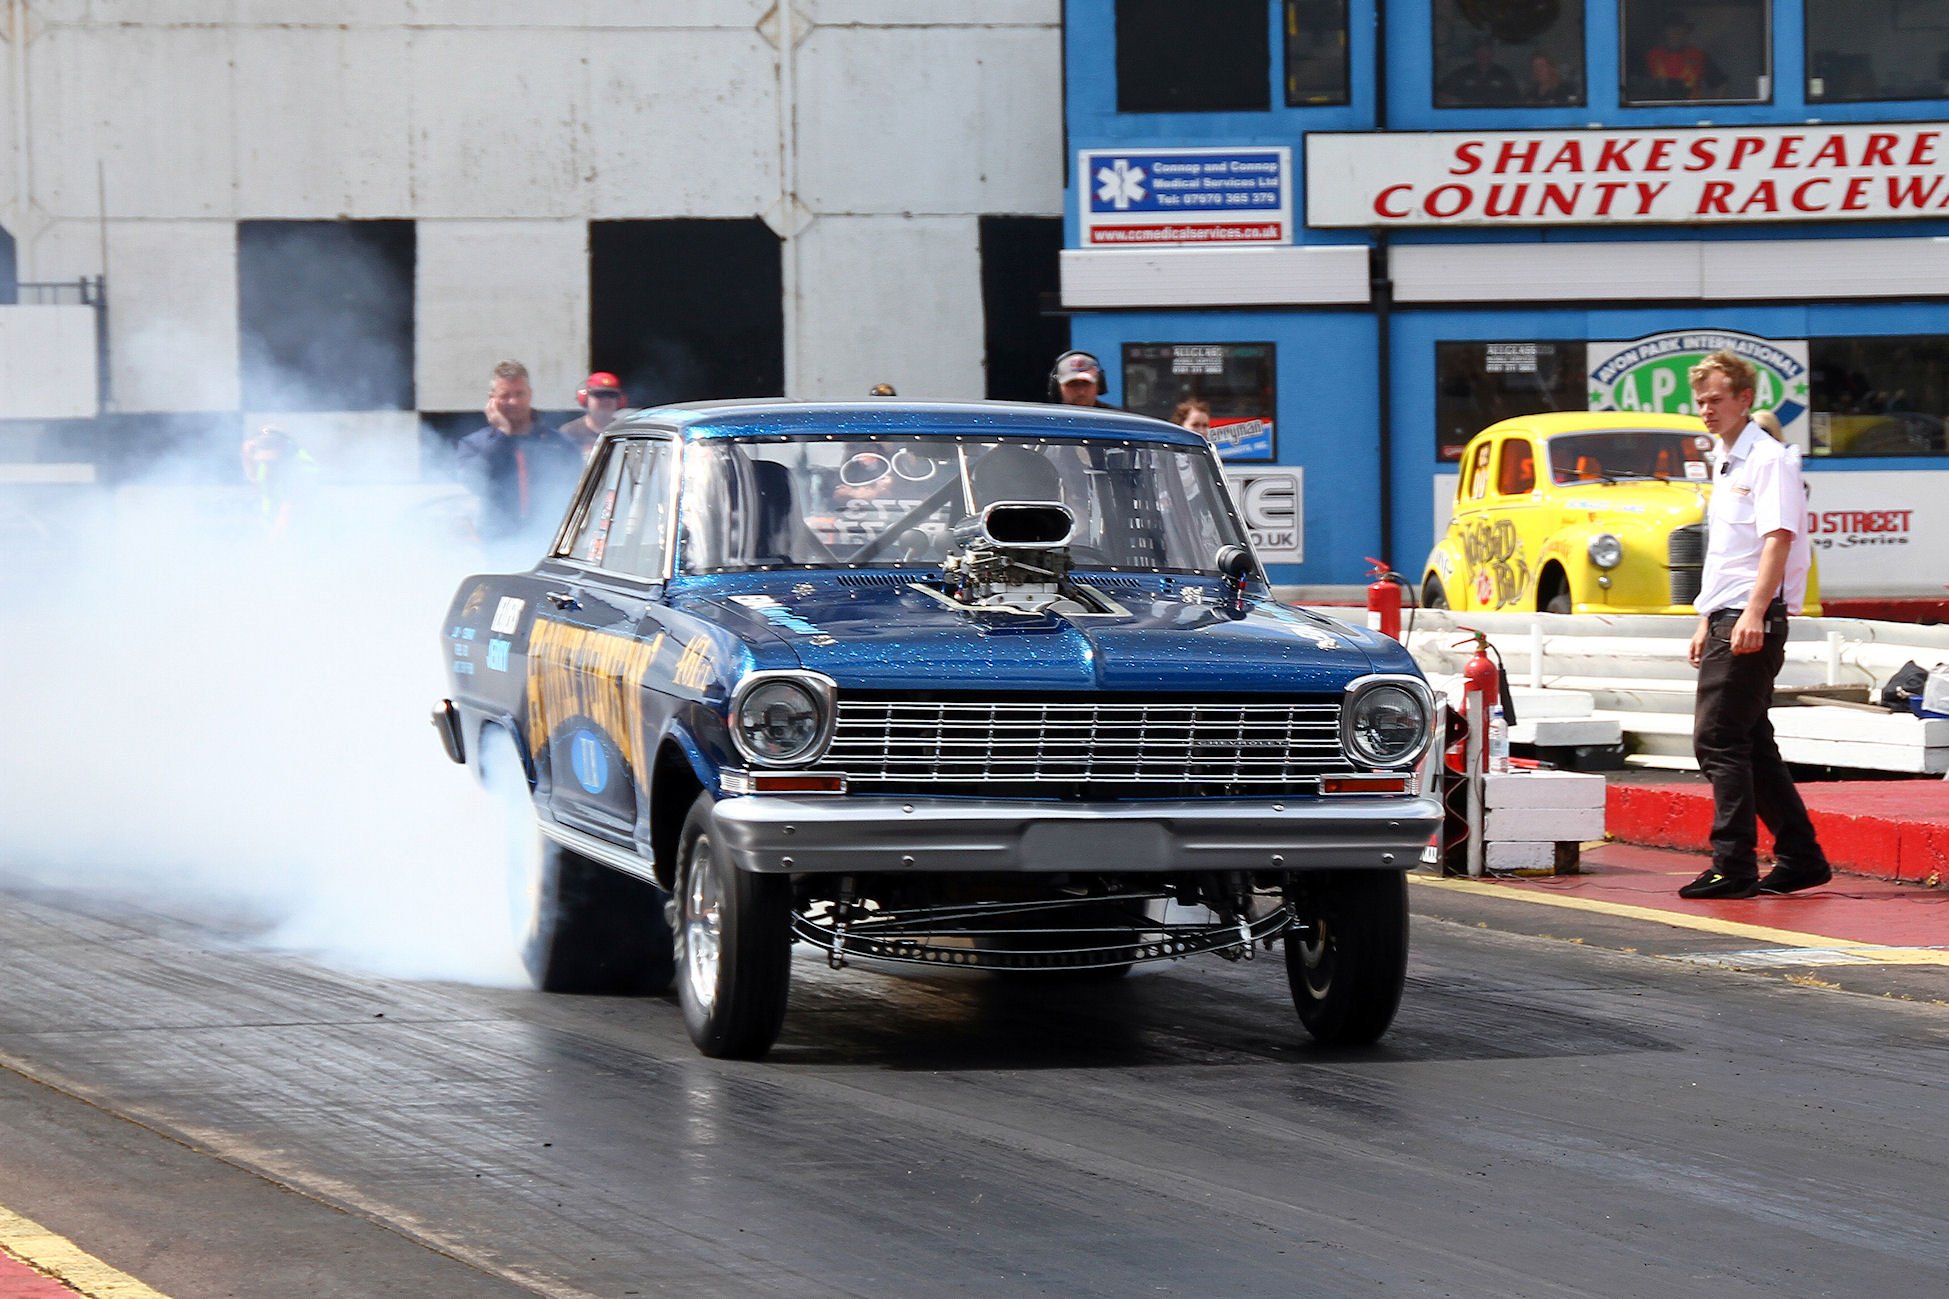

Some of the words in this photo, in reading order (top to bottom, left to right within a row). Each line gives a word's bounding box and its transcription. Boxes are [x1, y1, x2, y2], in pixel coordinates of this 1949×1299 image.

[1448, 130, 1942, 176] SHAKESPEARE
[1153, 161, 1201, 175] Connop
[1204, 161, 1228, 173] and
[1231, 161, 1279, 174] Connop
[1153, 178, 1200, 189] Medical
[1203, 177, 1256, 189] Services
[1259, 175, 1279, 188] Ltd
[1252, 191, 1276, 204] 379
[1372, 180, 1671, 218] COUNTY
[1695, 174, 1949, 215] RACEW
[1095, 224, 1278, 241] www.ccmedicalservices.co.uk
[1597, 350, 1639, 384] AVON
[1638, 337, 1682, 364] PARK
[1683, 334, 1798, 379] INTERNATIONAL
[1209, 421, 1263, 445] erryman
[1823, 510, 1914, 533] STREET
[1838, 534, 1910, 548] Series
